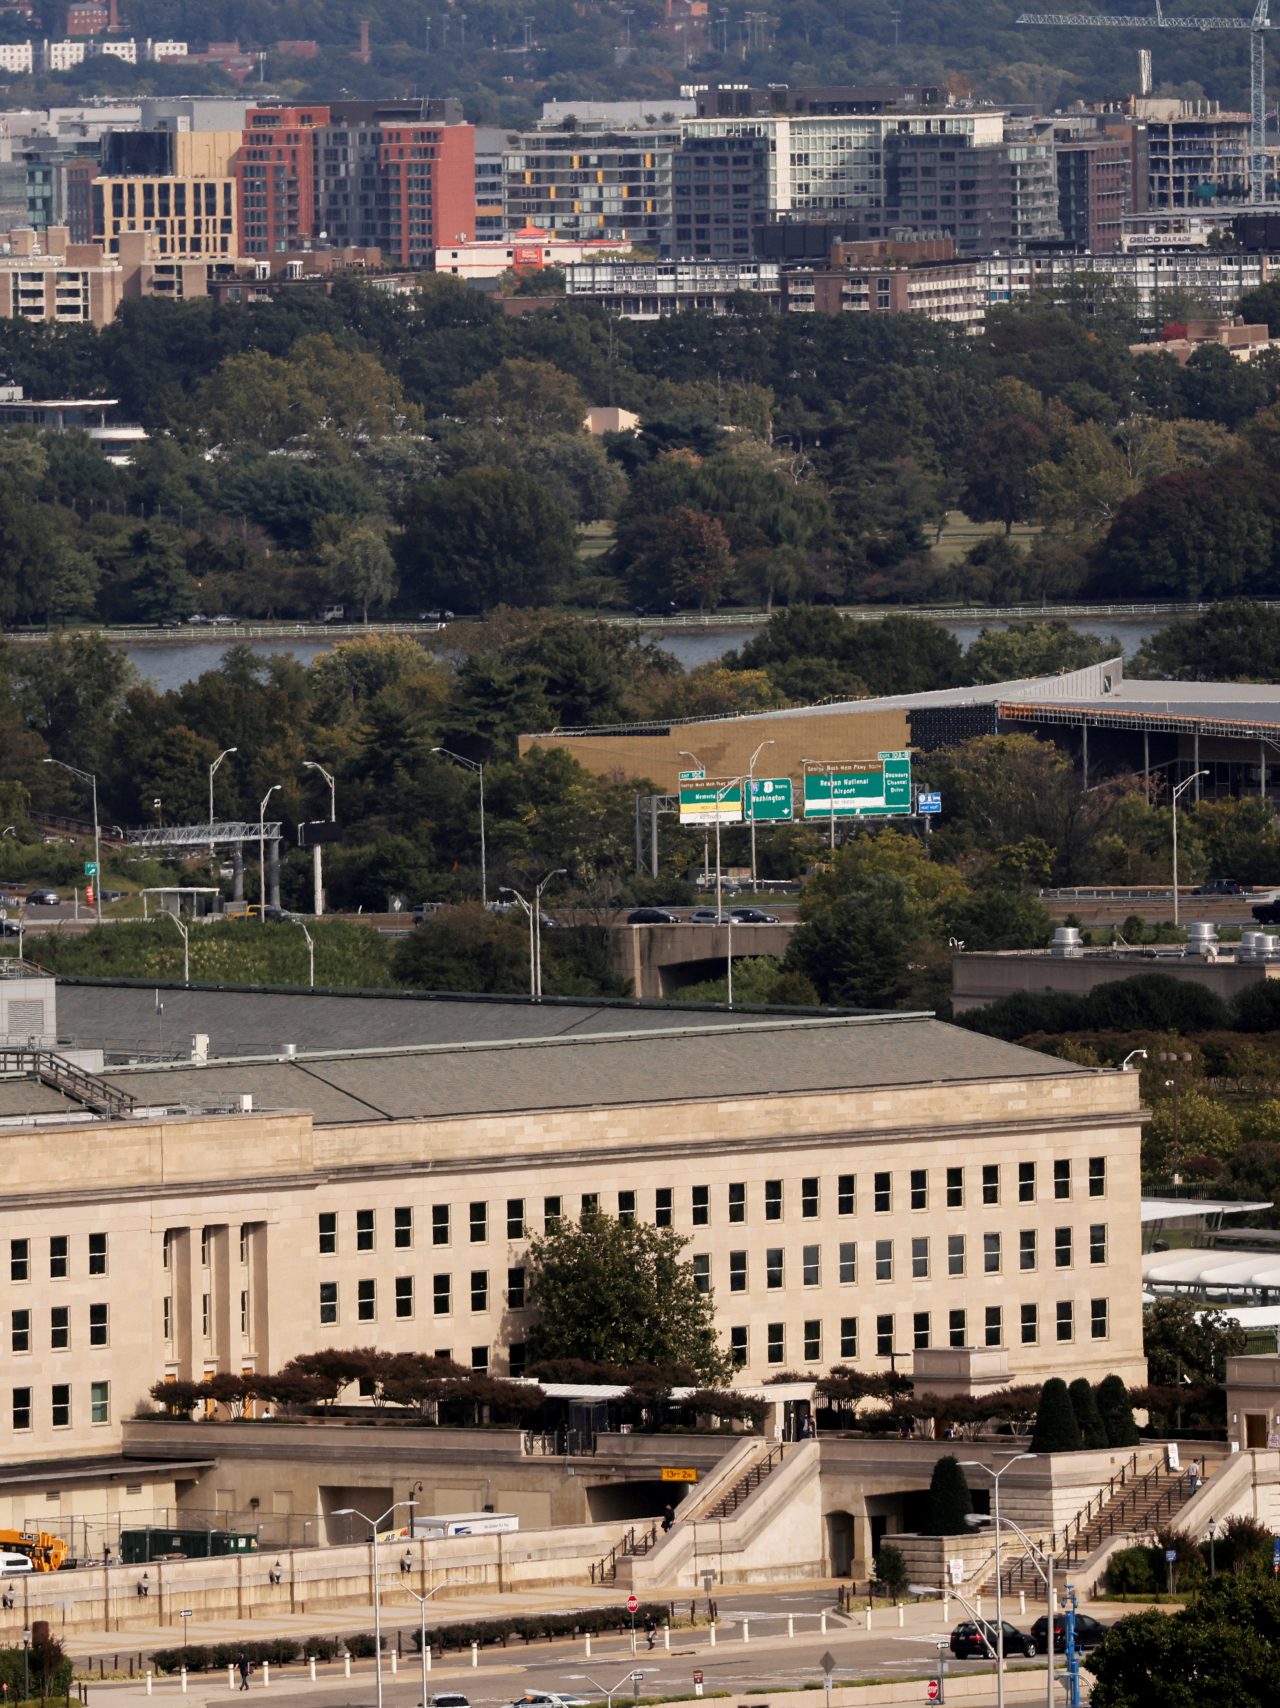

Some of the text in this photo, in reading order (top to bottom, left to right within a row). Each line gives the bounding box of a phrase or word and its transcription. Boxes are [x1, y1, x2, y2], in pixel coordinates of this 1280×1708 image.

[843, 778, 869, 786] National
[833, 787, 855, 795] Airport
[20, 1533, 40, 1541] JCB
